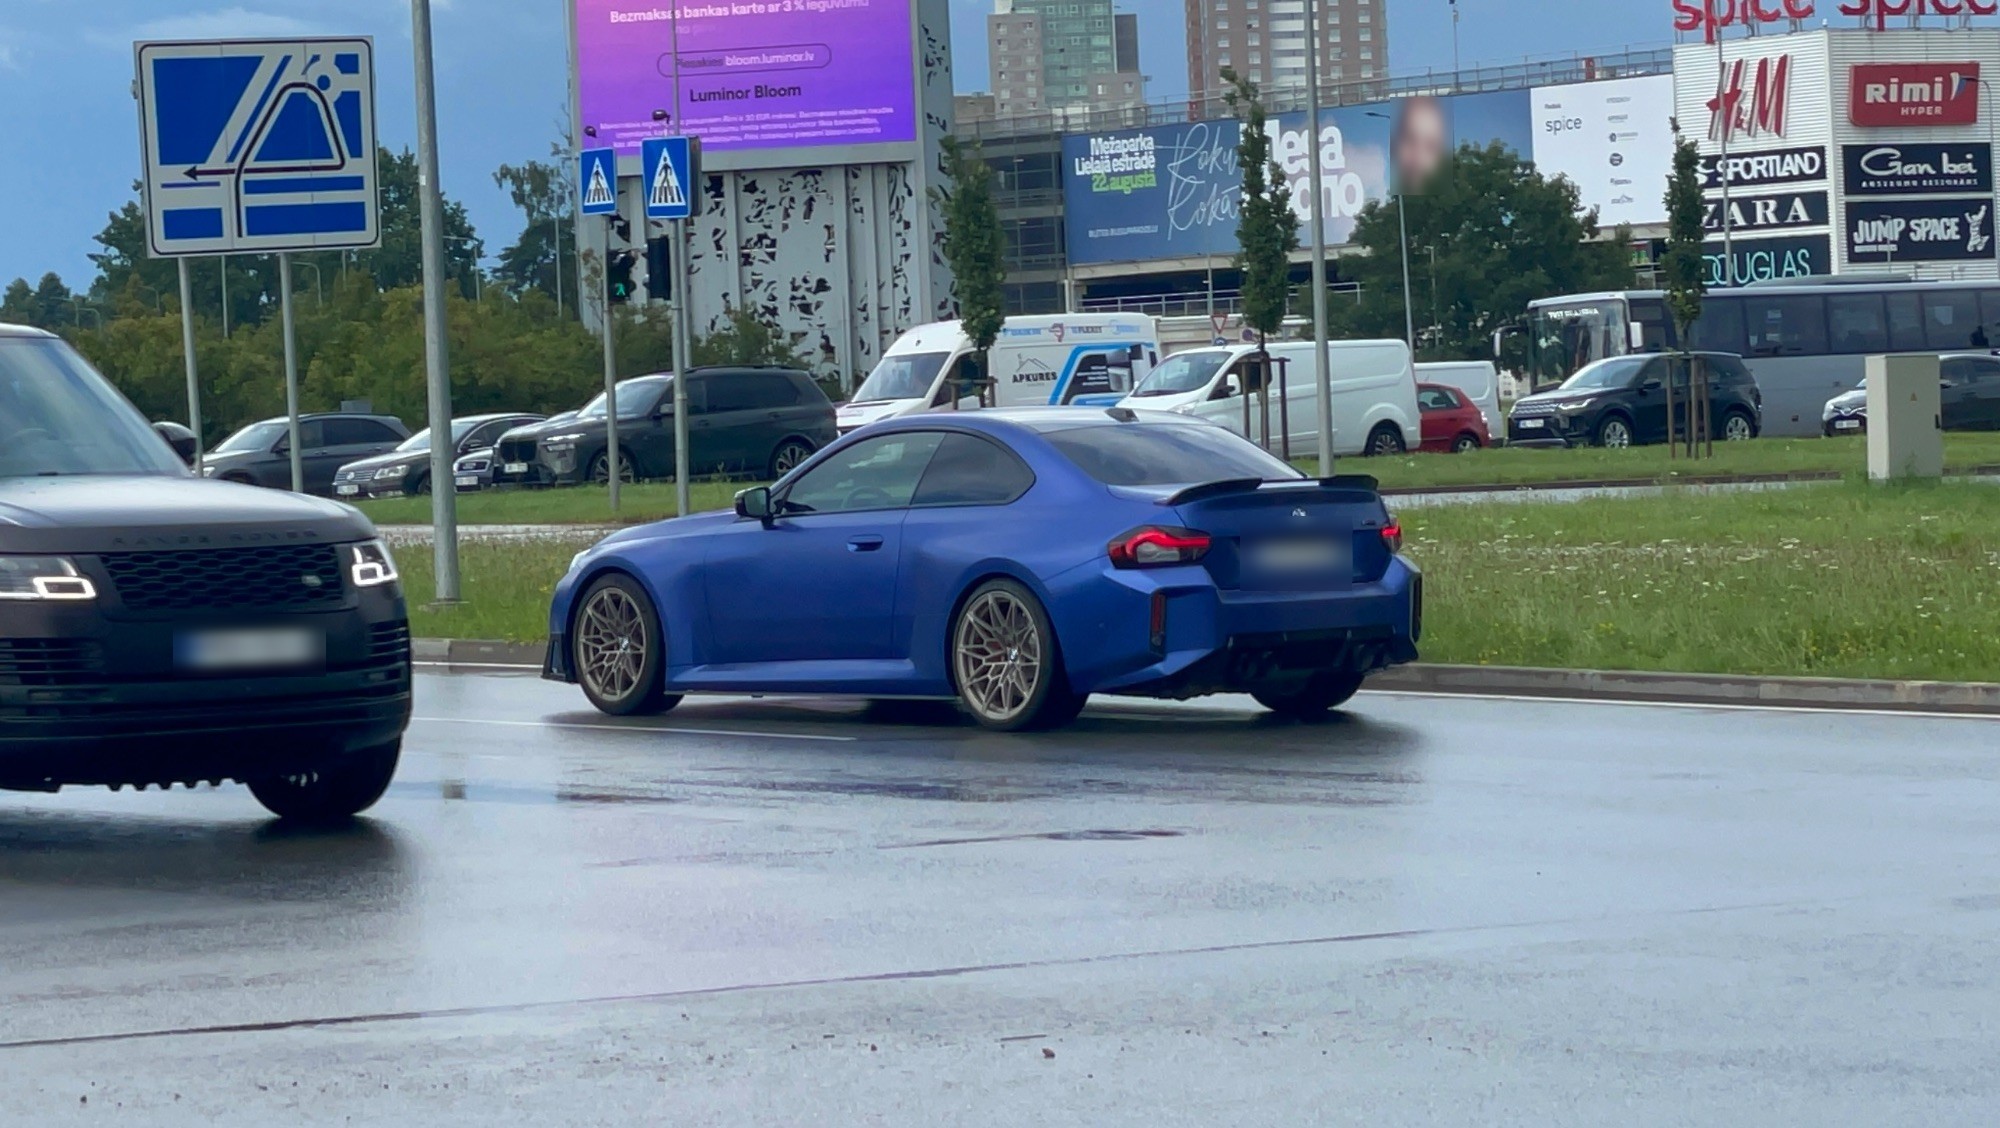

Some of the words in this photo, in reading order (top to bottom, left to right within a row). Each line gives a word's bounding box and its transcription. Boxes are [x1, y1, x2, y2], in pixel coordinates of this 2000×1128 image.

[610, 9, 681, 23] Bezmaksas
[683, 5, 729, 18] bankas
[731, 2, 765, 15] karte
[768, 2, 779, 13] ar
[783, 0, 792, 12] 3
[725, 51, 814, 66] bloom.luminor.lv
[689, 87, 751, 102] Luminor
[754, 85, 802, 98] Bloom
[1706, 53, 1790, 142] H&M
[1900, 106, 1943, 116] HYPER
[1545, 115, 1582, 136] spice
[1090, 133, 1155, 156] Mežaparka
[1075, 155, 1112, 176] Lielajā
[1112, 151, 1156, 172] estrādē
[1716, 152, 1820, 182] SPORTLAND
[1860, 147, 1937, 176] Gan
[1941, 152, 1978, 174] bei
[1701, 197, 1813, 229] ZARA
[1853, 218, 1906, 244] JUMP
[1909, 217, 1961, 241] SPACE
[1701, 248, 1812, 285] DOUGLAS
[1011, 371, 1058, 383] APKURES
